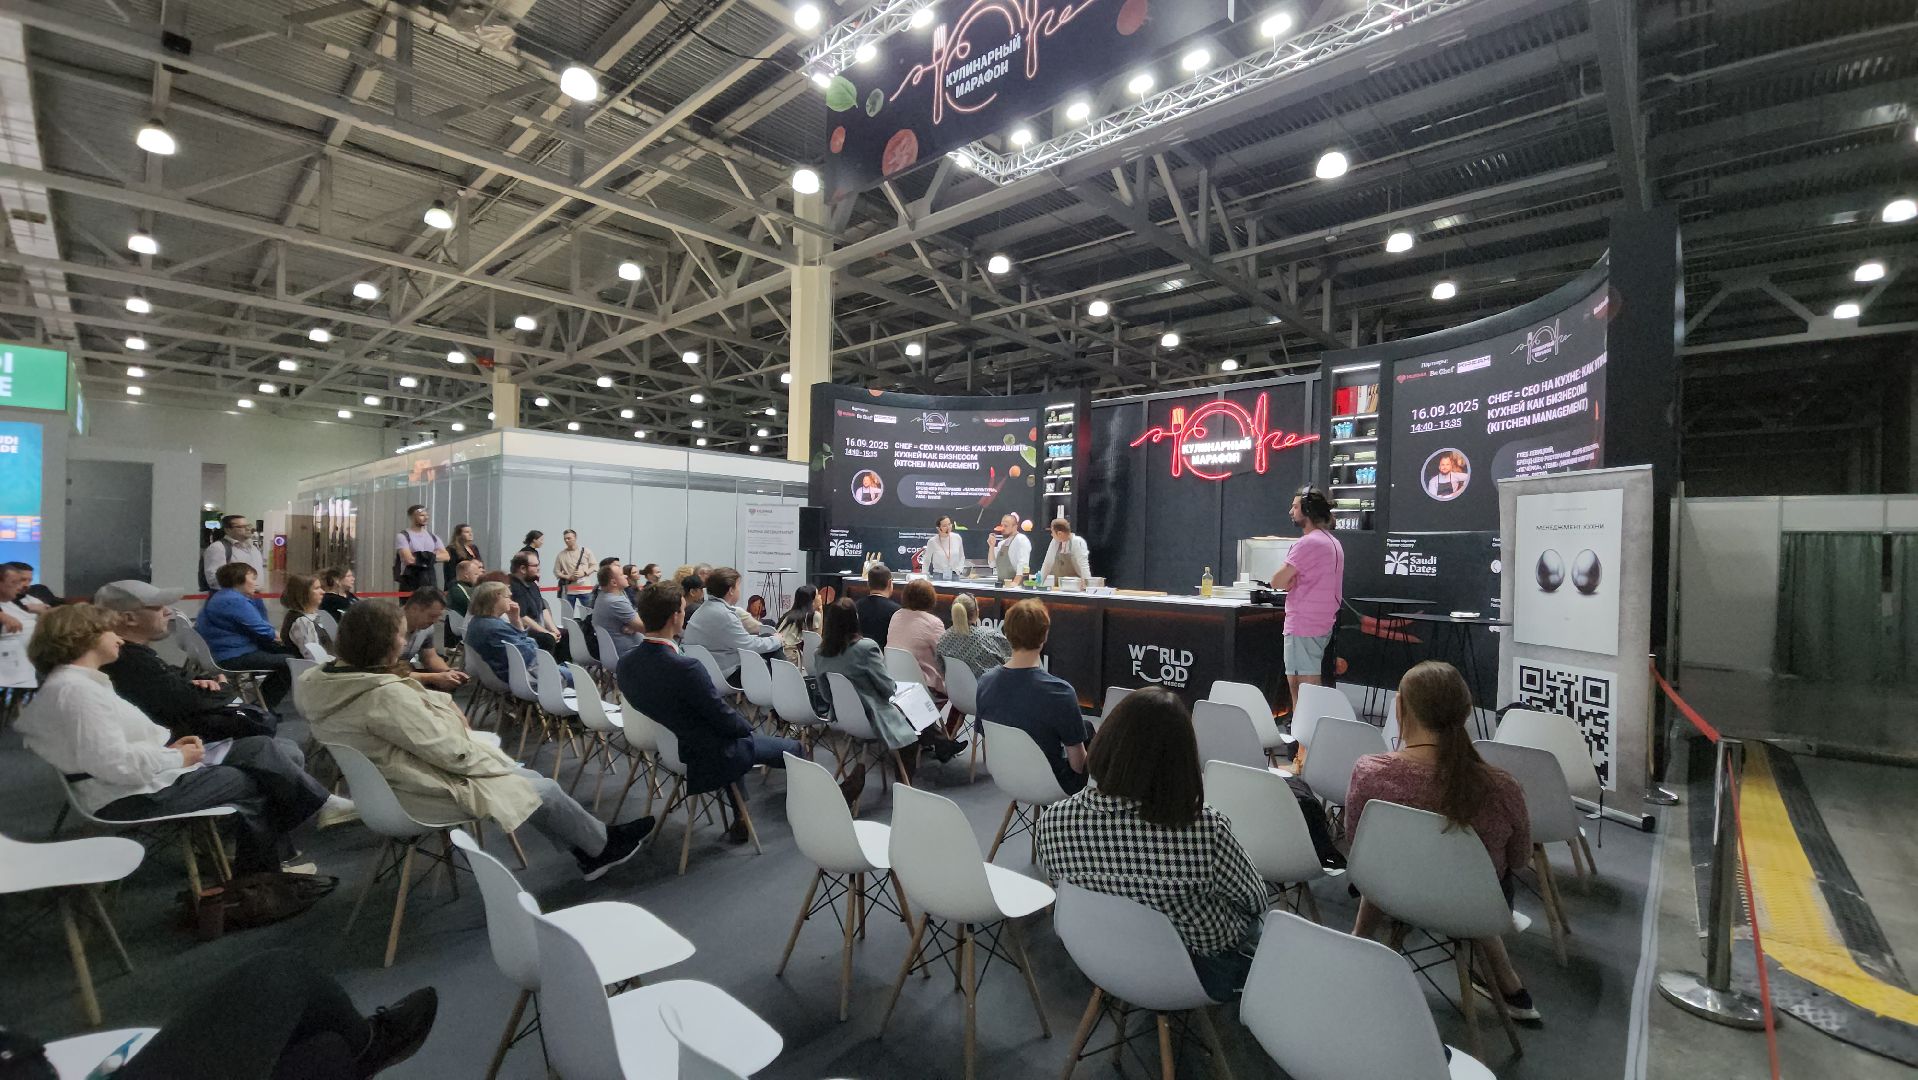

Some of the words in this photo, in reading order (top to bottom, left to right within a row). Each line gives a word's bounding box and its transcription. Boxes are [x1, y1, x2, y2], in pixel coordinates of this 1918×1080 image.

[946, 33, 1022, 87] КУЛИНАРНЫЙ
[956, 60, 1009, 98] МАРАФОН
[1488, 390, 1513, 404] CHEF
[1522, 384, 1540, 398] CEO
[1541, 380, 1554, 392] НА
[1554, 368, 1581, 388] КУХНЕ:
[1582, 359, 1594, 378] КАК
[1488, 400, 1524, 420] КУХНЕЙ
[1527, 397, 1544, 411] КАК
[1546, 382, 1588, 404] БИЗНЕСОМ
[1412, 398, 1479, 420] 16.09.2025
[1486, 415, 1530, 434] (KITCHEN
[1532, 398, 1588, 424] MANAGEMENT)
[1410, 422, 1434, 433] 14:40
[846, 438, 888, 450] 16.09.2025
[894, 442, 912, 450] CHEF
[1182, 436, 1252, 454] КУЛИНАРНЫЙ
[894, 451, 922, 459] КУХНЕЙ
[938, 453, 978, 461] БИЗНЕСОМ
[1192, 452, 1240, 465] МАРАФОН
[894, 459, 926, 468] (KITCHEN
[927, 462, 980, 470] MANAGEMENT)
[1410, 556, 1437, 565] Saudi
[1410, 565, 1436, 573] Dates
